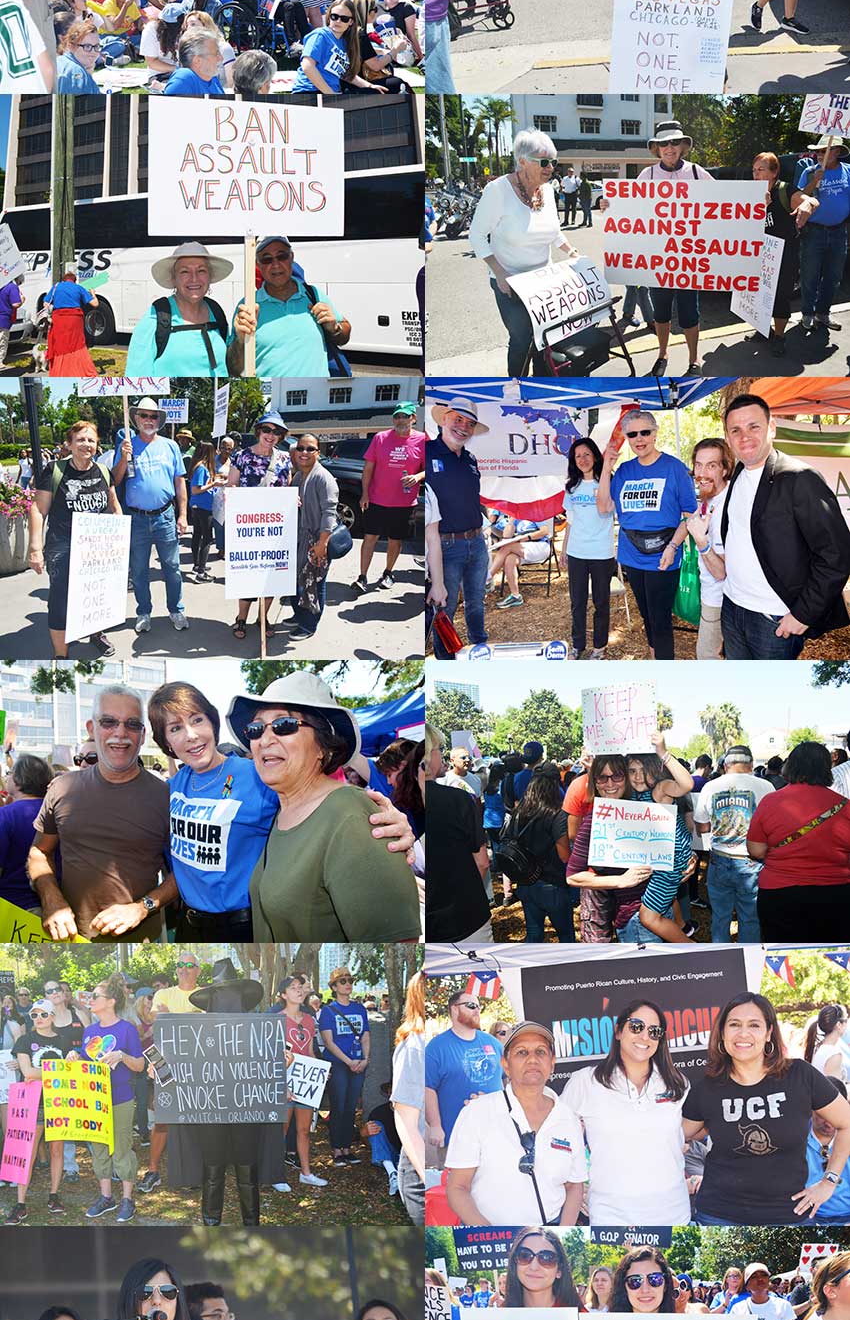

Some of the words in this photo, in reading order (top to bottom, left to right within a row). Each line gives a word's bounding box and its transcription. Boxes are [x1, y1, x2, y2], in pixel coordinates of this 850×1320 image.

[636, 1, 715, 17] PARKLAND
[637, 31, 679, 49] NOT.
[636, 51, 681, 71] ONE.
[215, 106, 289, 143] BAN
[180, 143, 317, 175] ASSAULT
[179, 179, 326, 212] WEAPONS
[605, 181, 688, 198] SENIOR
[655, 202, 766, 220] CITIZENS
[604, 218, 701, 236] AGAINST
[664, 238, 764, 256] ASSAULT
[604, 253, 710, 273] WEAPONS
[655, 272, 760, 292] VIOLENCE
[623, 490, 639, 500] FOR
[640, 490, 658, 499] OUR
[624, 482, 654, 491] MARCH
[622, 500, 645, 509] LIVES
[236, 513, 284, 524] CONGRESS:
[236, 527, 265, 537] YOU'RE
[267, 526, 283, 536] NOT
[229, 550, 289, 561] BALLOT-PROOF!
[594, 687, 638, 722] KEEP
[716, 797, 749, 809] MIAMI
[545, 984, 574, 992] Promoting
[575, 981, 595, 989] Puerto
[596, 979, 613, 987] Rican
[613, 977, 636, 987] Culture,
[637, 975, 659, 985] History,
[687, 970, 723, 980] Engagement
[161, 1024, 205, 1058] HEX
[215, 1023, 244, 1057] THE
[251, 1020, 286, 1061] NRA
[43, 1061, 72, 1072] KIDS
[202, 1061, 226, 1084] GUN
[229, 1061, 284, 1079] VIOLENCE
[43, 1079, 77, 1089] COME
[82, 1080, 107, 1095] HOME
[45, 1097, 88, 1109] SCHOOL
[176, 1085, 227, 1112] INVOKE
[234, 1081, 285, 1108] CHANGE
[722, 1092, 786, 1123] UCF
[46, 1118, 70, 1128] NOT
[76, 1120, 102, 1132] BODY
